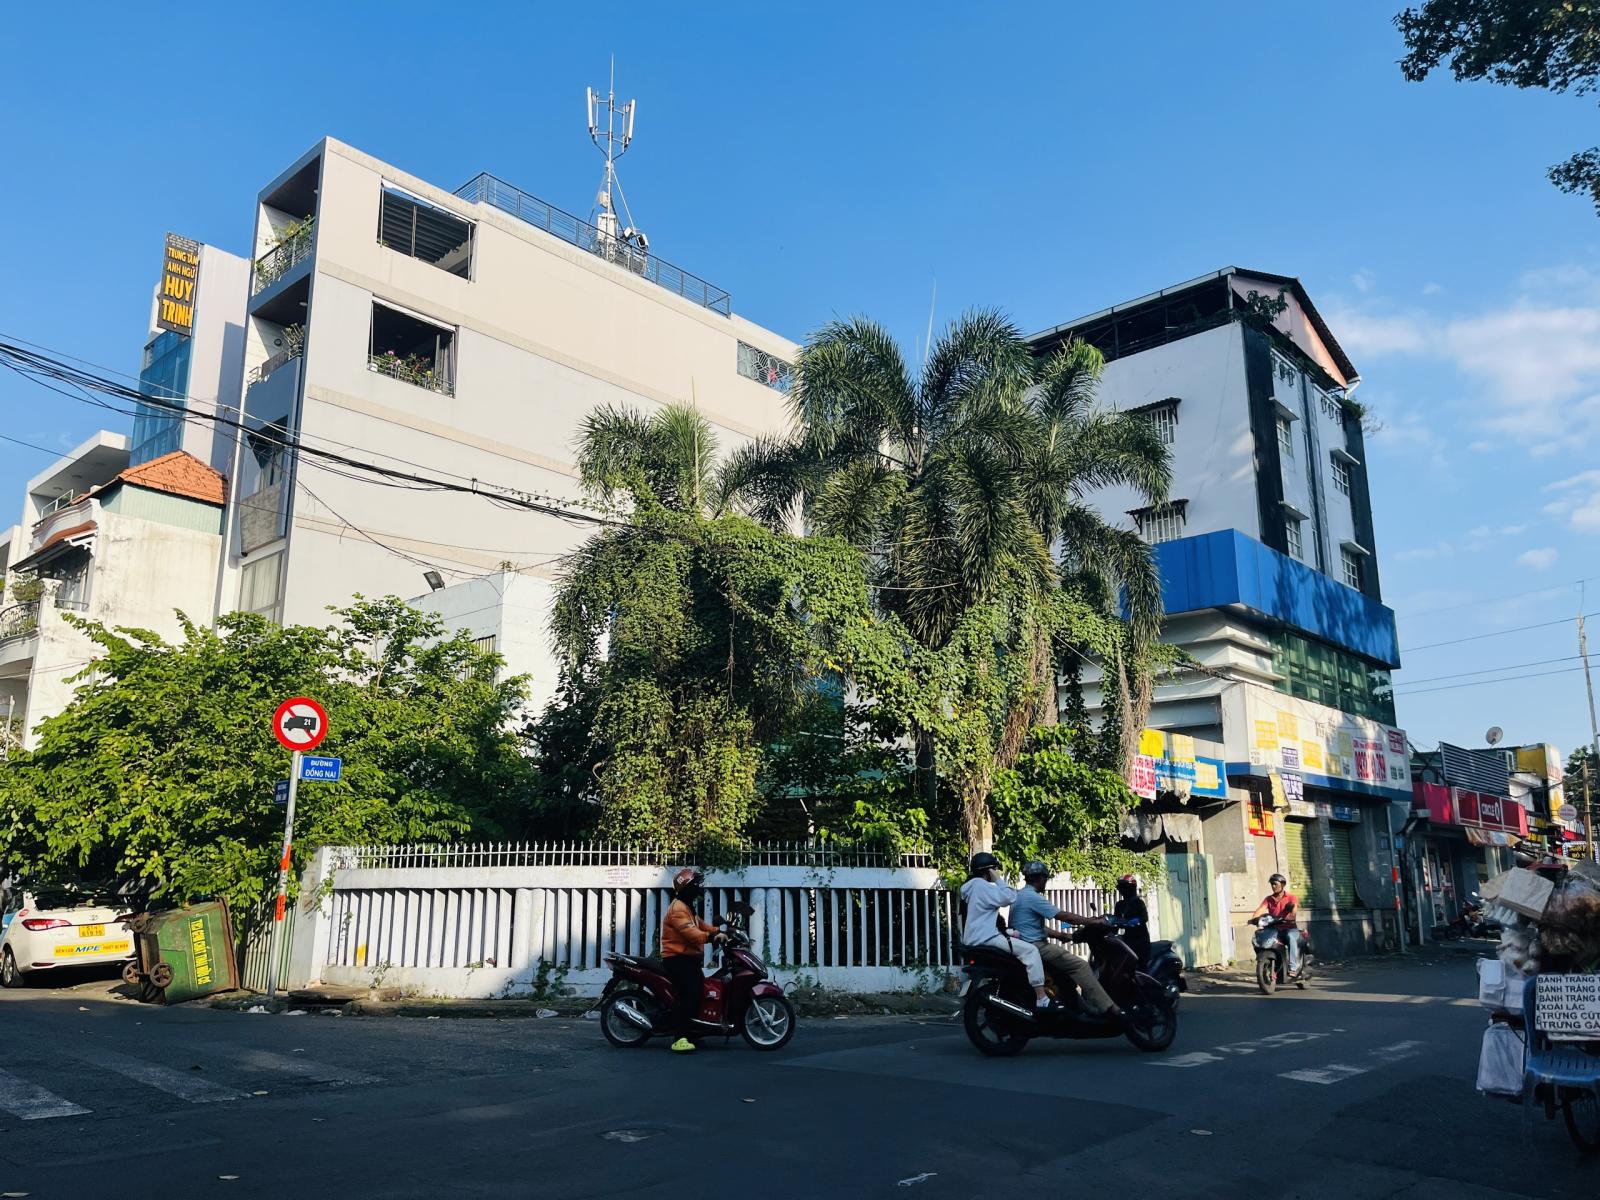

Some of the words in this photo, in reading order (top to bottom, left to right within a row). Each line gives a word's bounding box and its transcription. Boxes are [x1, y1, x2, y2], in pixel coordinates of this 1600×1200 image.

[168, 247, 186, 262] TRUNG
[167, 260, 181, 274] ANH
[164, 274, 193, 302] HUY
[162, 299, 193, 328] TRỊNH
[305, 767, 324, 778] ĐỒNG
[75, 945, 101, 953] MPE
